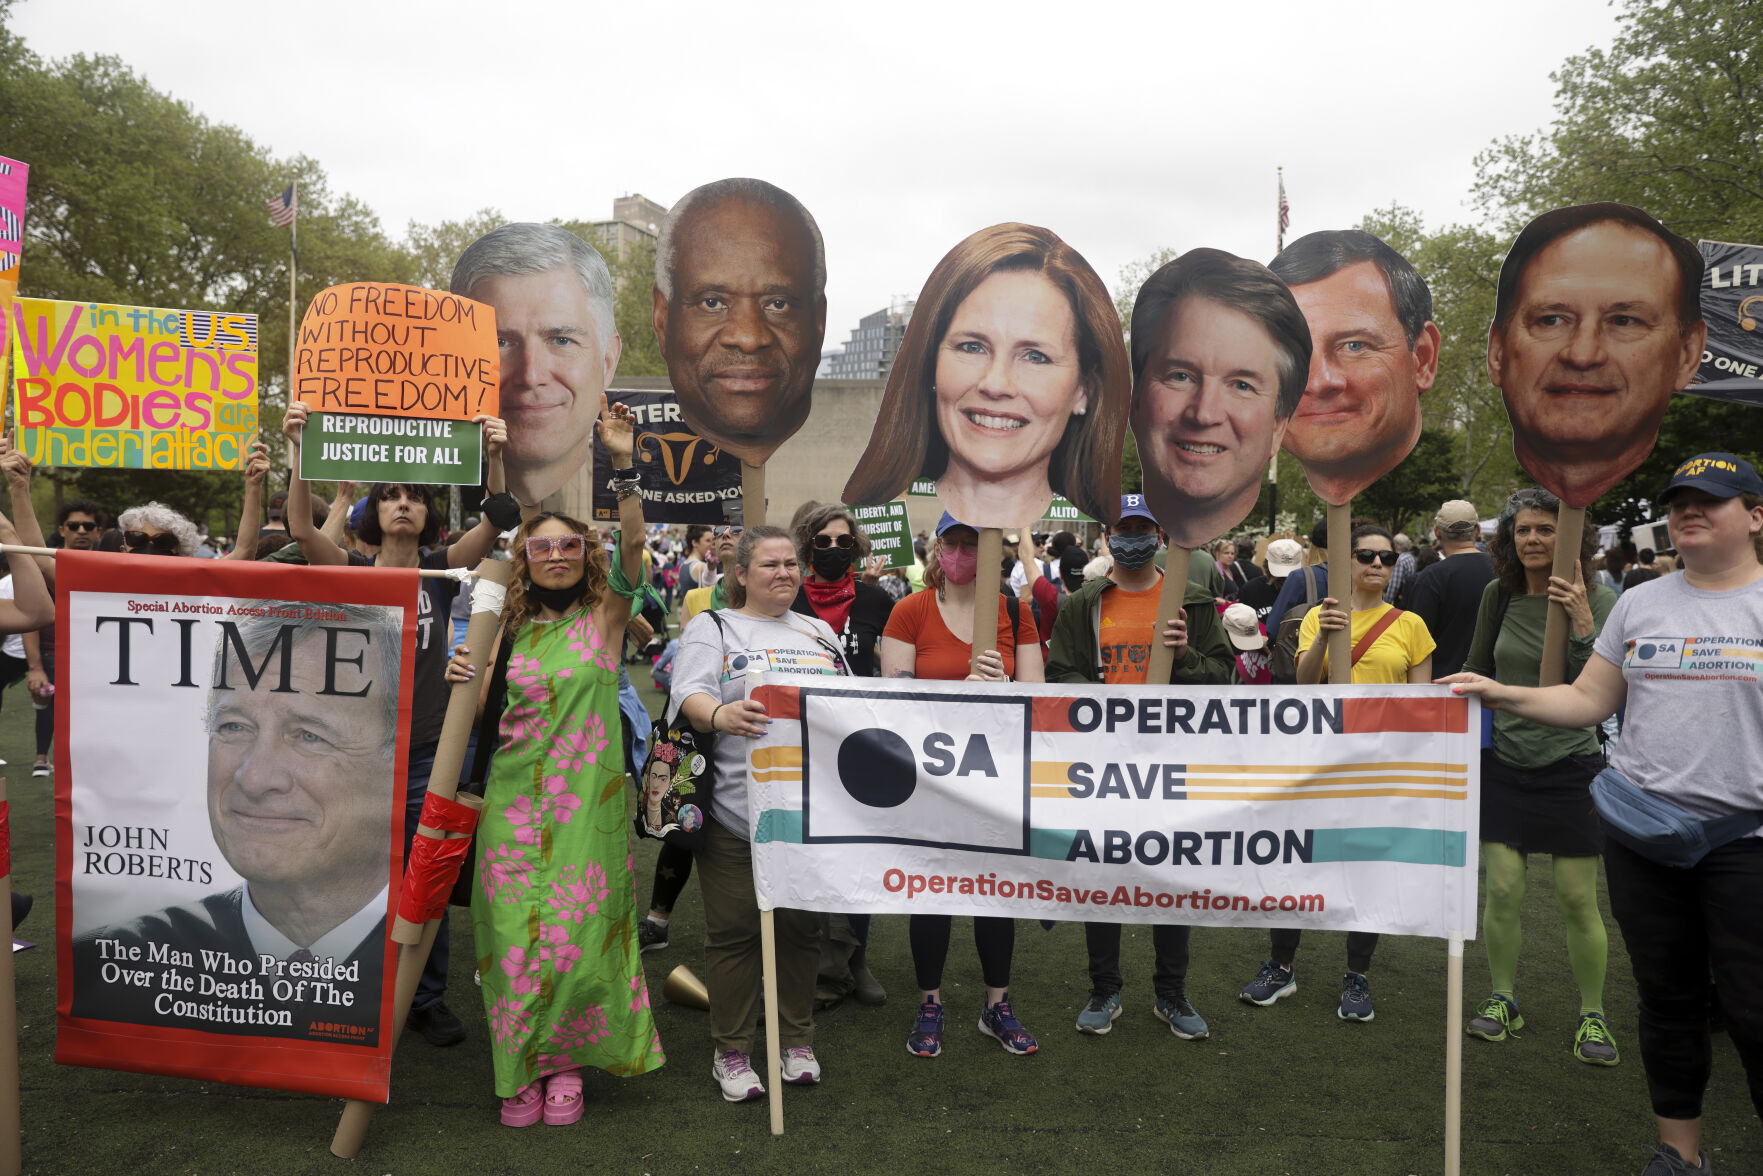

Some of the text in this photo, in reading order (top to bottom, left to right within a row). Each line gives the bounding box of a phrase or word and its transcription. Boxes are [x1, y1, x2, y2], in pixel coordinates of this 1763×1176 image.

[306, 286, 476, 331] NO FREEDOM
[89, 304, 257, 351] in the U.S.
[303, 320, 437, 347] WITHOUT
[297, 347, 495, 386] REPRODUCTIVE
[1714, 357, 1758, 378] ONE
[298, 377, 487, 415] FREEDOM!
[219, 402, 257, 431] are
[322, 415, 453, 438] REPRODUCTIVE
[16, 425, 142, 468] Under
[321, 443, 462, 465] JUSTICE FOR ALL
[1685, 467, 1706, 477] AF
[664, 492, 716, 504] ASKED
[1127, 494, 1140, 507] B
[854, 504, 904, 519] LIBERTY, AND
[1050, 506, 1079, 519] ALITO
[893, 521, 902, 532] OF
[127, 600, 347, 622] Special Abortion Access Front Edition
[773, 648, 820, 657] OPERATION
[1695, 636, 1763, 647] OPERATION
[95, 615, 373, 698] TIME
[1689, 661, 1755, 671] ABORTION
[778, 667, 822, 675] ABORTION
[1067, 697, 1344, 734] OPERATION
[1066, 761, 1188, 800] SAVE
[83, 825, 170, 850] JOHN
[1065, 828, 1314, 866] ABORTION
[83, 851, 213, 885] ROBERTS
[882, 868, 1325, 912] OperationSaveAbortion.com
[96, 938, 360, 983] The Man Who Presided
[101, 962, 355, 1007] Over the Death Of The
[155, 993, 293, 1026] Constitution
[310, 1021, 366, 1036] ABORTION
